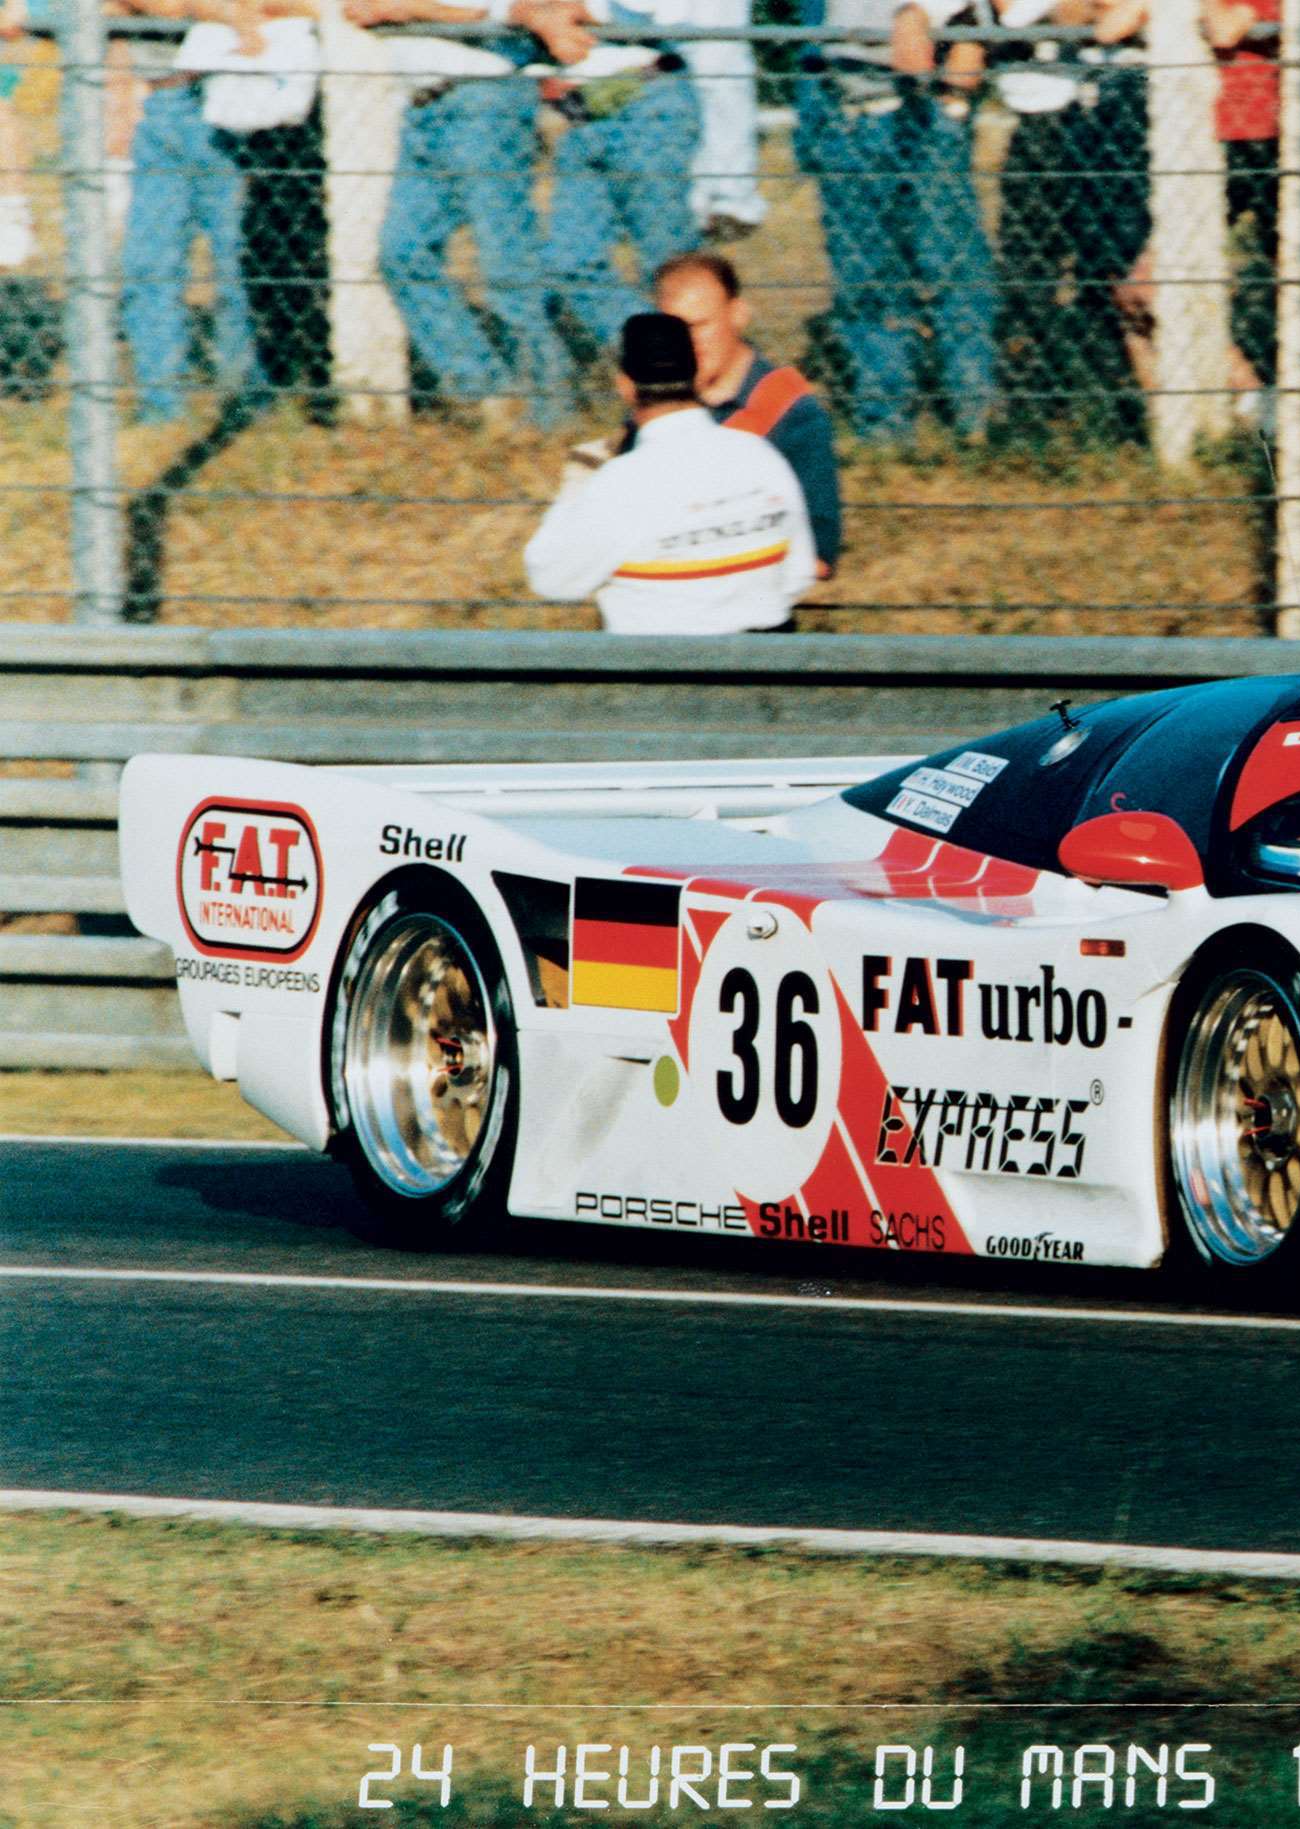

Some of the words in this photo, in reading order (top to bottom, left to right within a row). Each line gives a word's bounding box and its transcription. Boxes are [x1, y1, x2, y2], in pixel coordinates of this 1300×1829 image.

[380, 825, 467, 862] Shell
[200, 900, 296, 934] INTERNATIONAL
[175, 957, 241, 985] GROUPAGES
[716, 966, 820, 1129] 36
[575, 1192, 747, 1231] PORSCHE
[759, 1202, 849, 1242] Shell
[869, 1209, 946, 1250] SACHS
